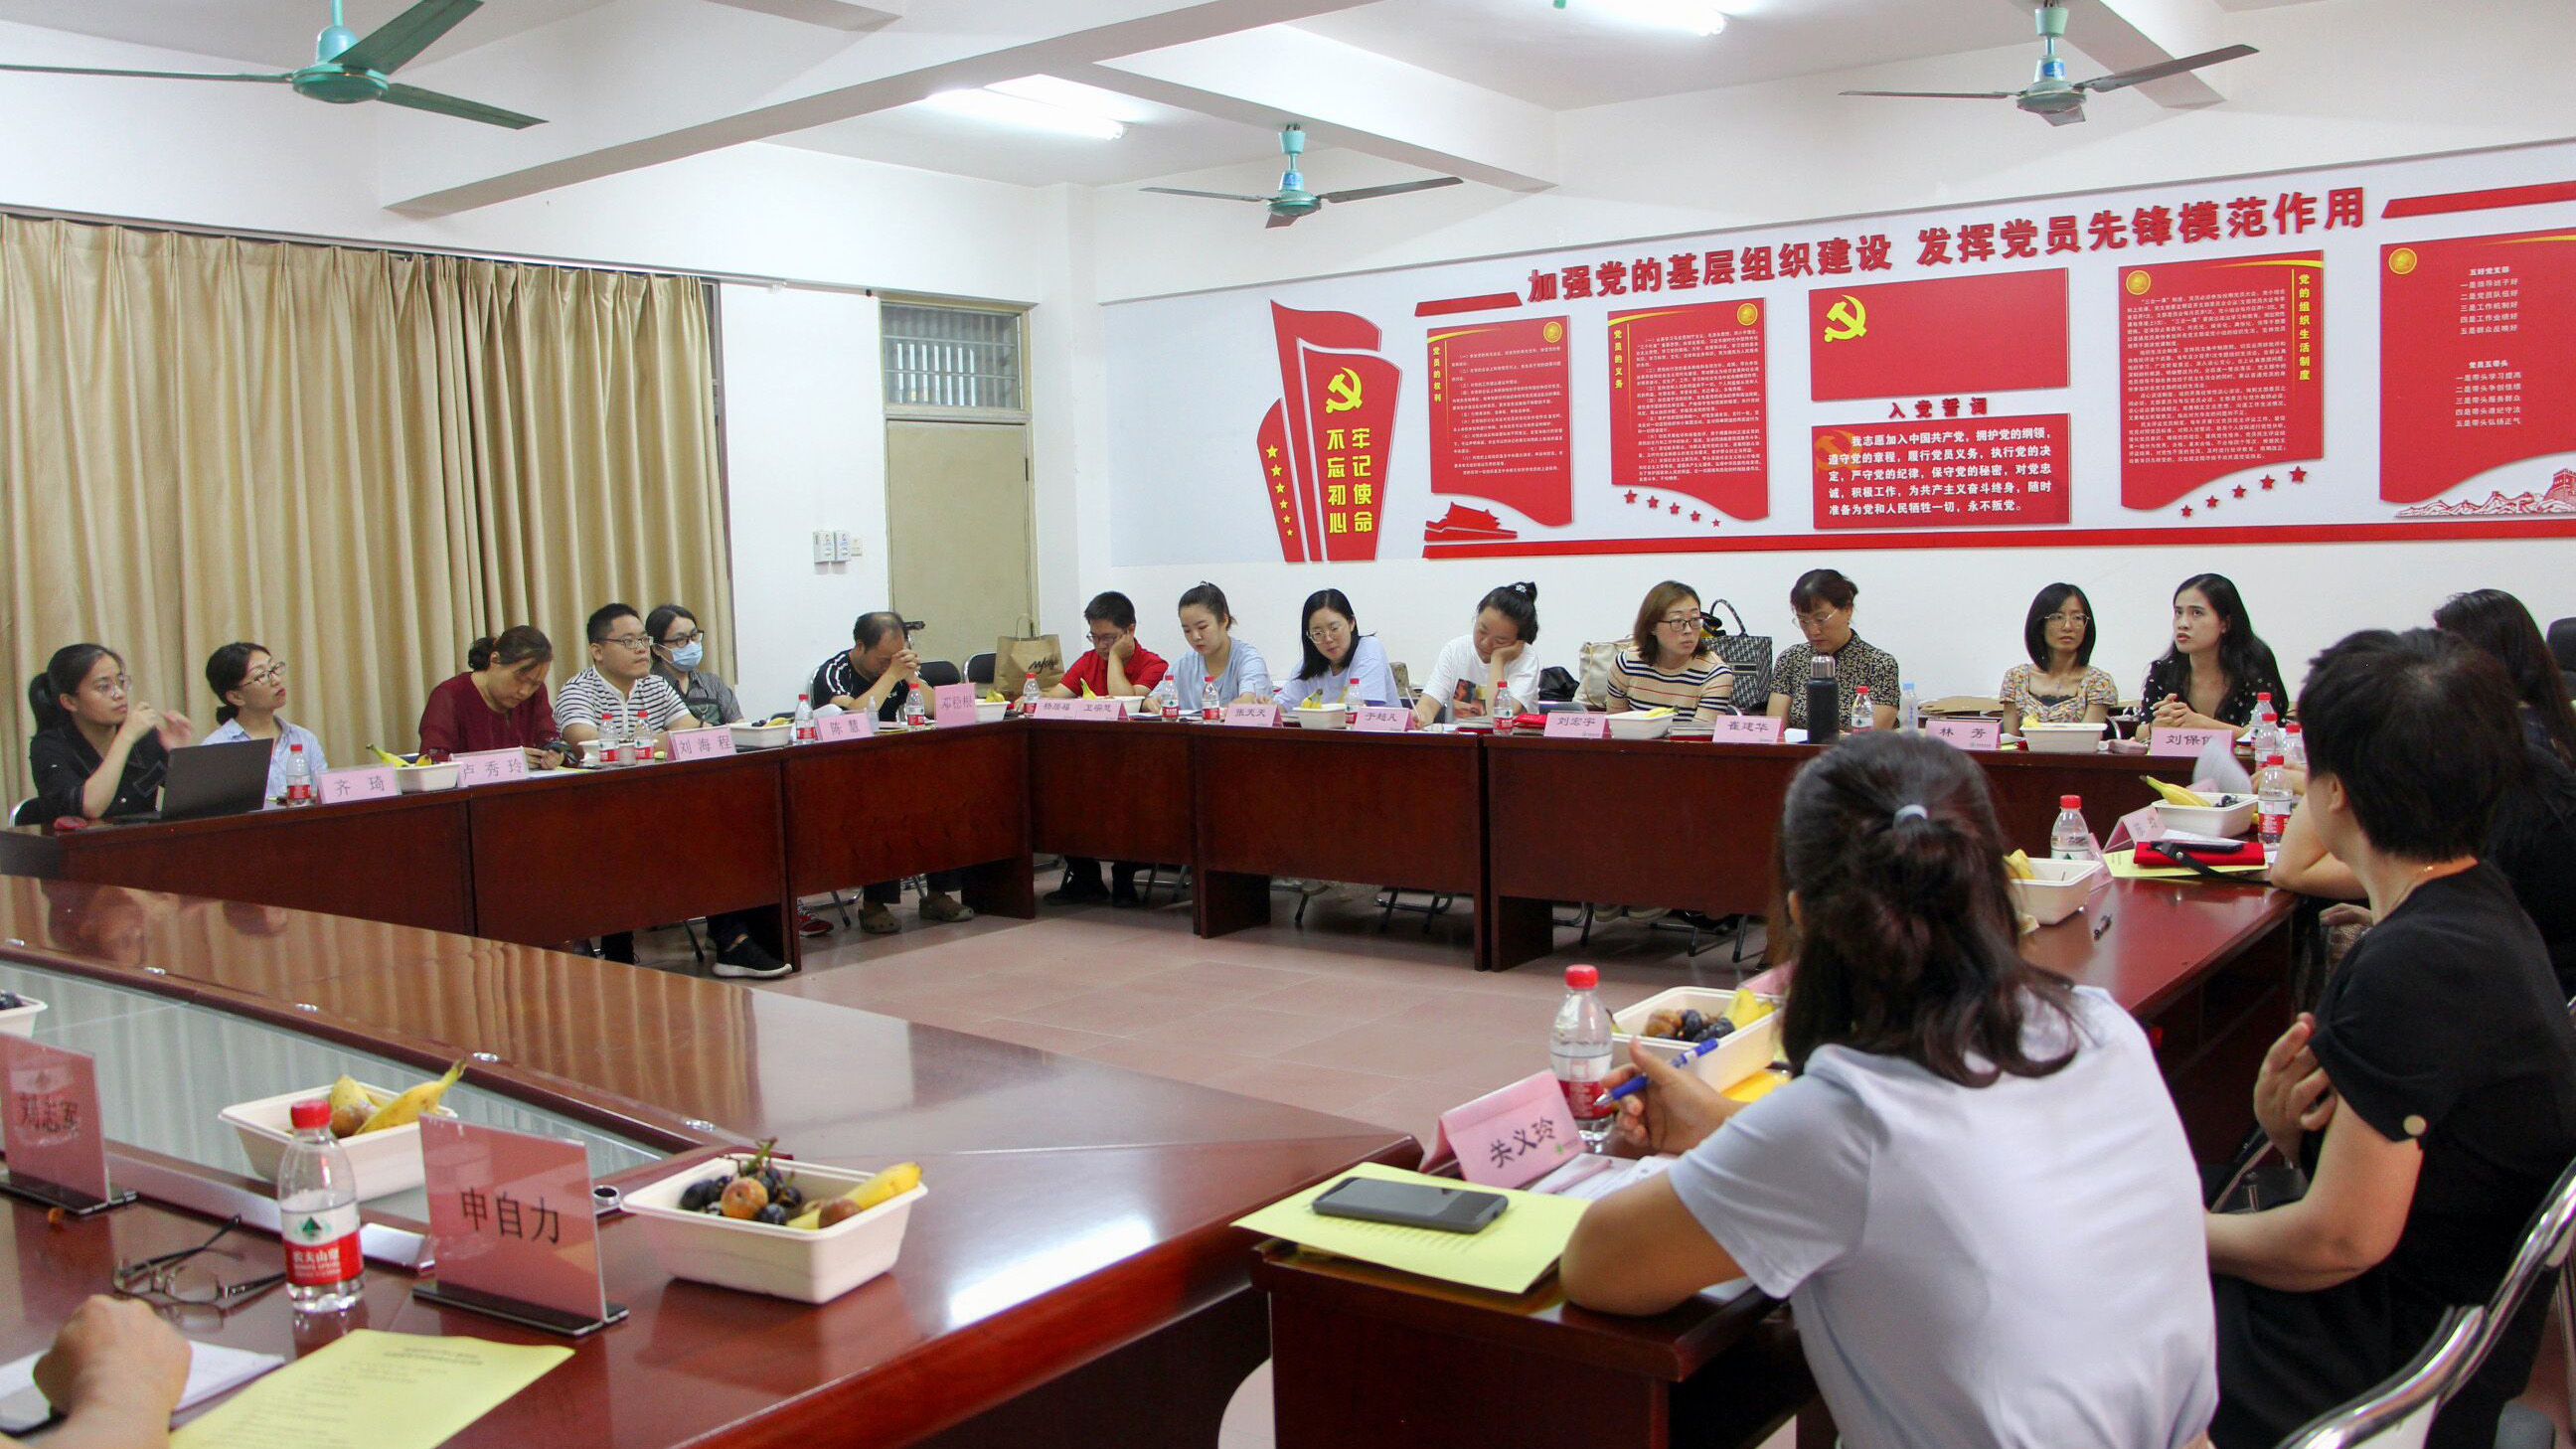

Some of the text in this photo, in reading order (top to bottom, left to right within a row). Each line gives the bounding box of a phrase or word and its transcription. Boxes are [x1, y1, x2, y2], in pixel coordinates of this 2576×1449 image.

[1917, 188, 2365, 265] 发挥党员先锋模范作用
[1528, 235, 1892, 302] 加强党的基层组织建设
[2299, 273, 2311, 381] 党的组织生活制度
[1432, 347, 1442, 402] 党员的权利
[1614, 329, 1623, 389] 党员的义务
[1888, 398, 1989, 418] 入党誓词
[1327, 428, 1348, 534] 不忘初心
[1352, 427, 1372, 533] 牢记使命
[679, 735, 732, 755] 刘海程
[461, 1186, 562, 1245] 申自力
